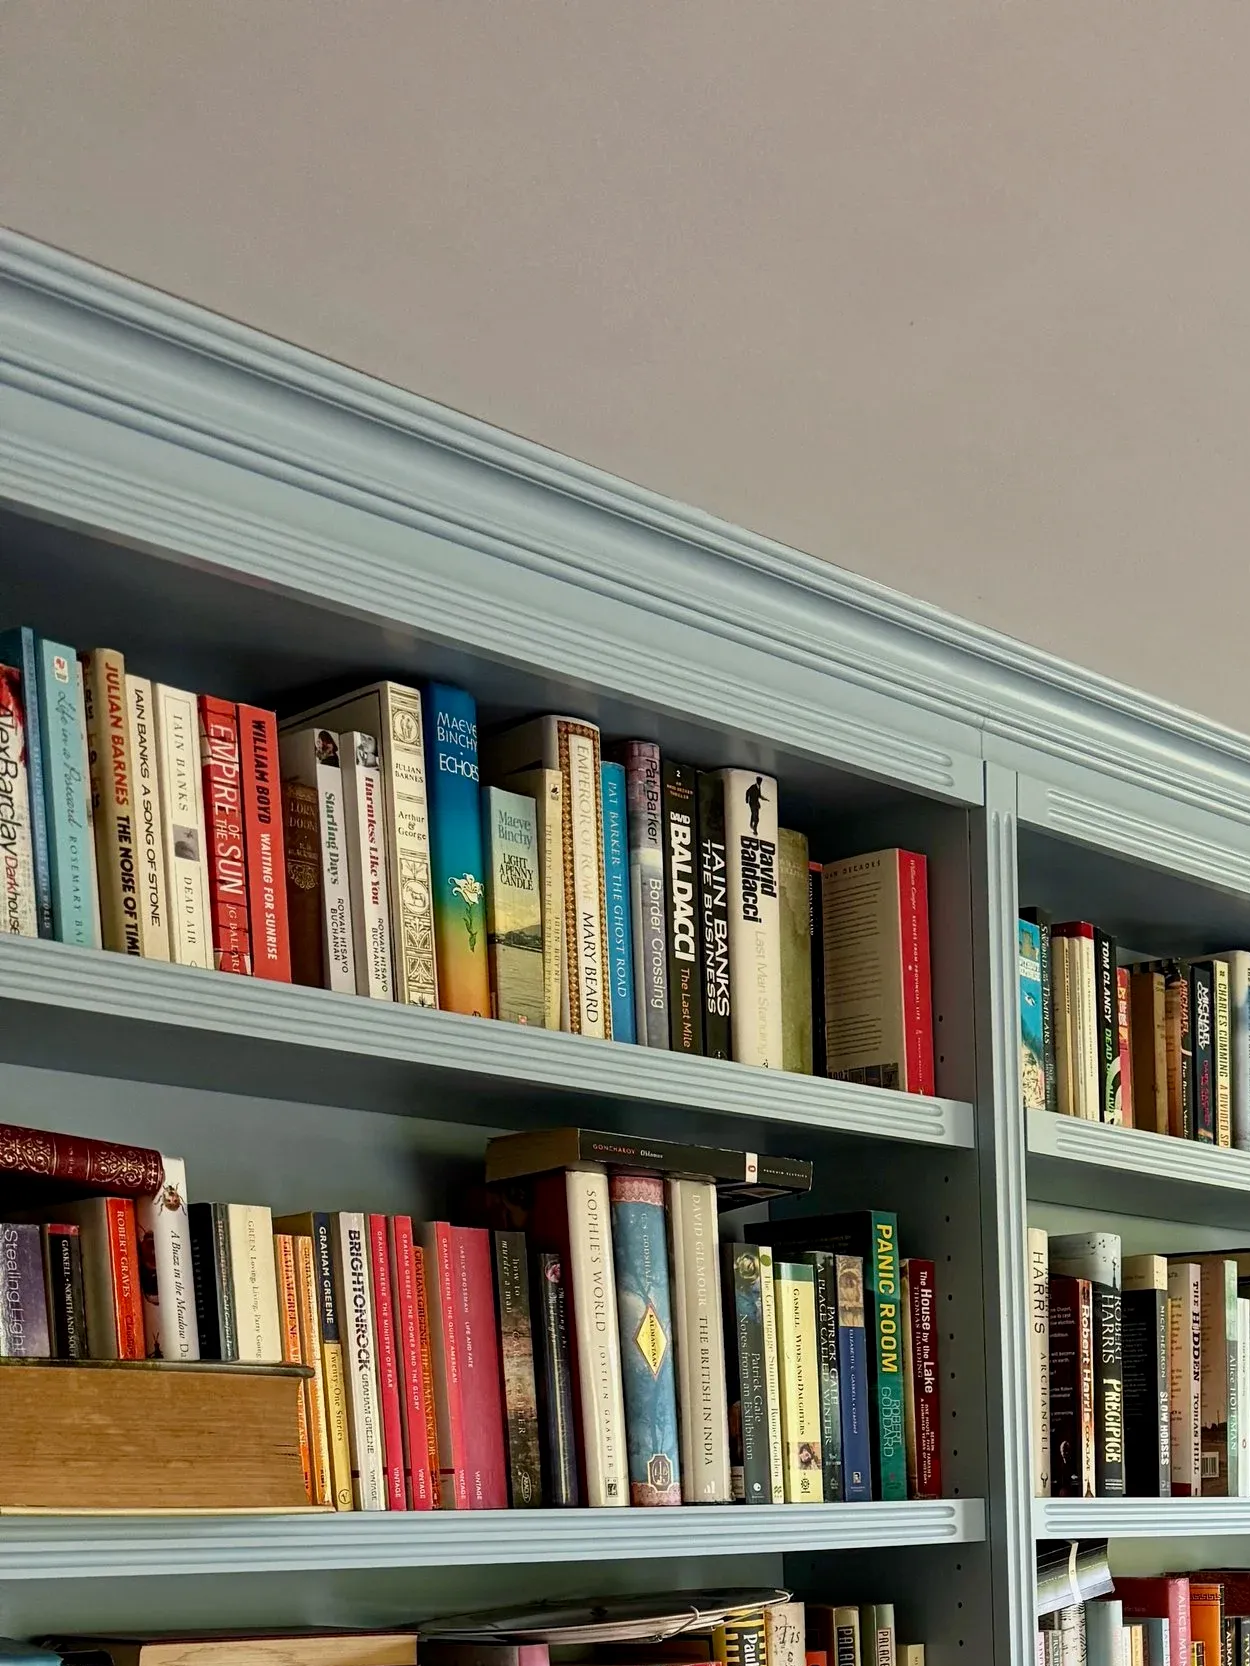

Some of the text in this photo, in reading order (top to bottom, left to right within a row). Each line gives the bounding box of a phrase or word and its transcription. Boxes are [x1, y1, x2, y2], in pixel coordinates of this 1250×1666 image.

[437, 712, 478, 736] MAEVE
[437, 727, 478, 752] BINCHY
[438, 754, 481, 782] ECHOES
[134, 689, 160, 926] IAIN BANKS A SONG OF STONE
[210, 724, 244, 894] EMPIRE OF THE SUN
[252, 720, 278, 959] WILLIAM BOYD WAITING FOR SUNRISE
[363, 776, 383, 905] Harmless Like You
[703, 839, 716, 1013] THE BUSINESS
[741, 834, 761, 924] Baldacci
[760, 839, 775, 898] David
[584, 912, 599, 1023] MARY BEARD
[670, 823, 695, 1047] BALDACCI The Last Mile
[711, 842, 729, 1016] IAIN BANKS
[1102, 941, 1111, 1022] TOM CLANCY
[1218, 983, 1228, 1077] CHARLES CUMMING
[116, 1211, 131, 1298] ROBERT GRAVES
[586, 1190, 606, 1332] SOPHIE'S WORLD
[877, 1225, 898, 1372] PANIC ROOM
[319, 1227, 345, 1441] GRAHAM GREENE Twenty-One Stories
[692, 1194, 714, 1466] DAVID GILMOUR THE BRITISH IN INDIA
[1033, 1251, 1048, 1452] HARRIS ARCHANGEL
[1082, 1305, 1091, 1423] Robert Harris
[1103, 1379, 1122, 1463] PRECIPICE
[1160, 1392, 1169, 1465] SLOW HORSES
[1179, 1595, 1187, 1632] ALICE
